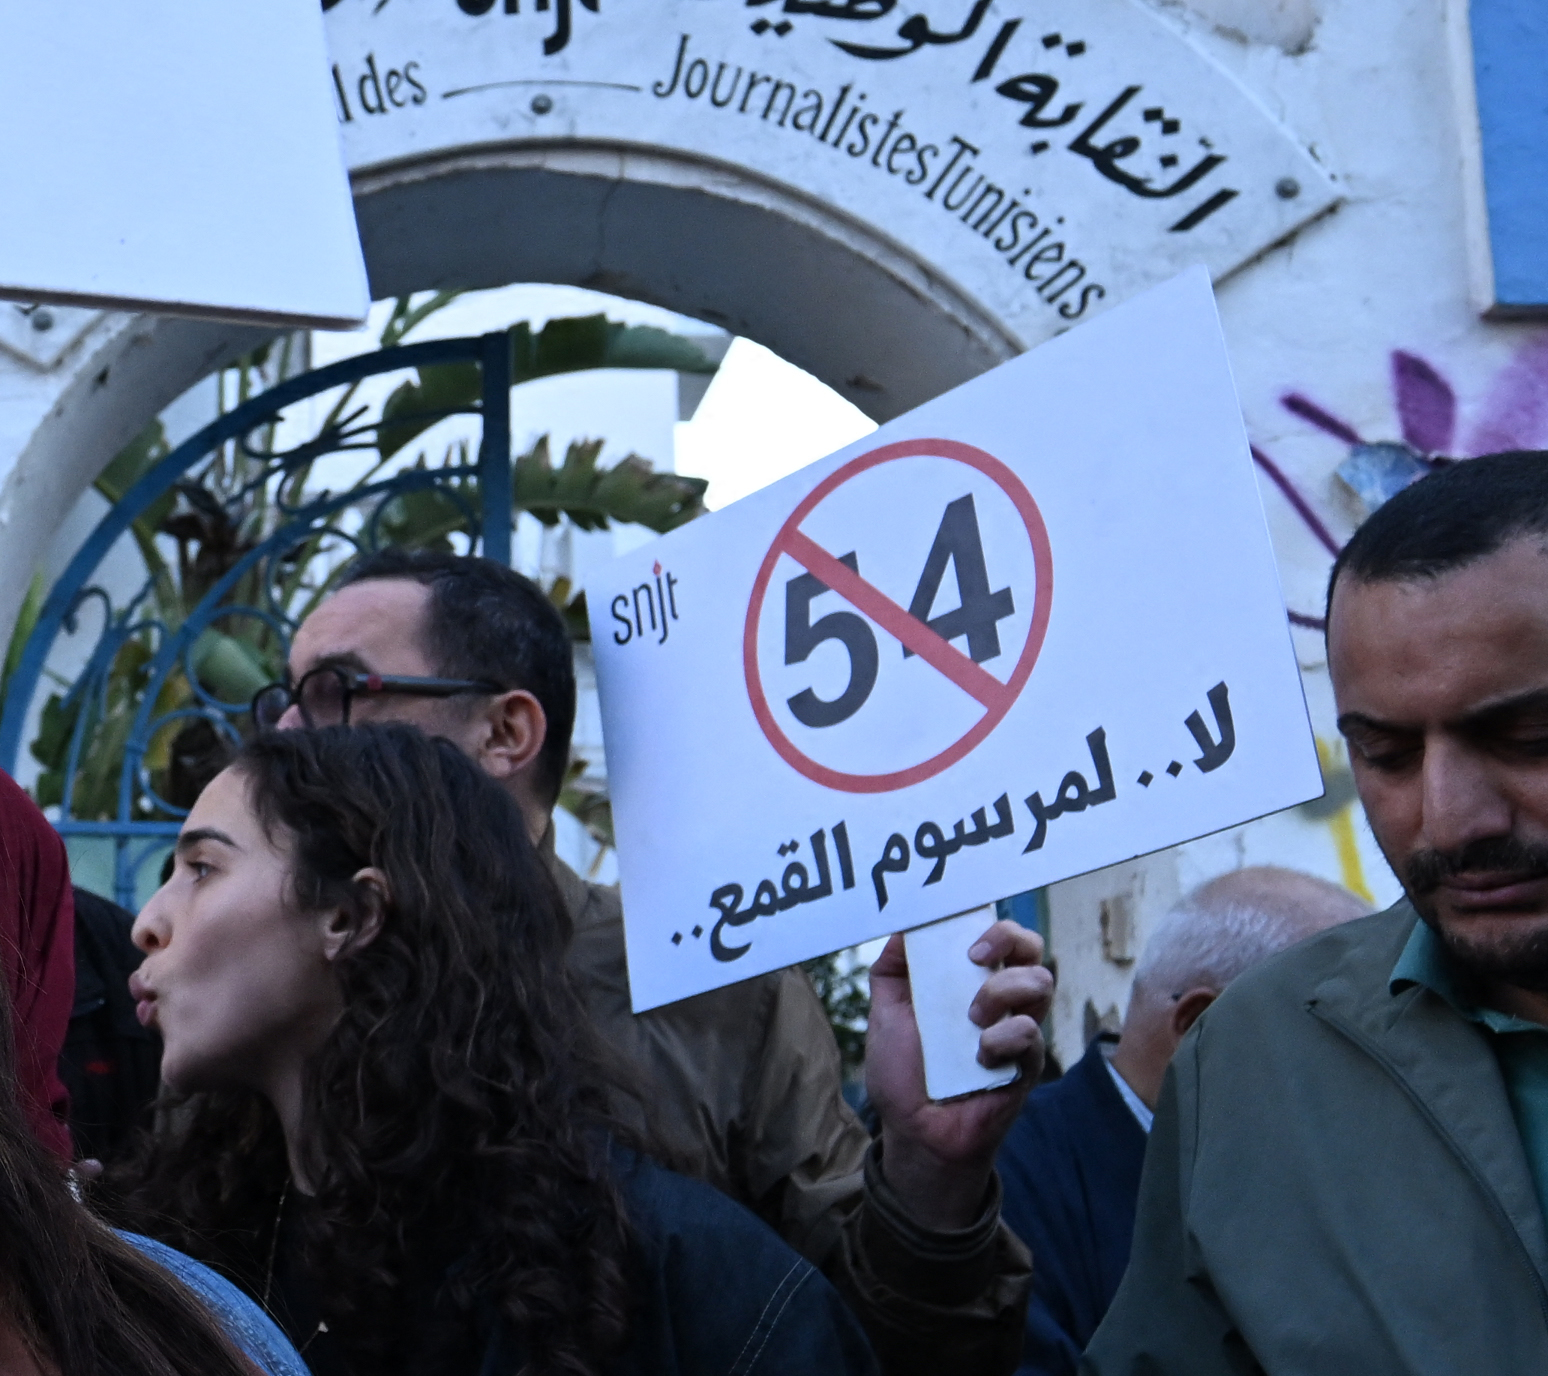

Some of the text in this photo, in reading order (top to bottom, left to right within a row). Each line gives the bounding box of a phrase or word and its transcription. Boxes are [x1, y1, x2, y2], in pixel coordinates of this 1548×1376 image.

[358, 33, 1106, 321] des Journalistes Tunisiens
[610, 561, 680, 646] snjt
[783, 492, 1016, 729] 54
[870, 726, 1117, 912] لمرسوم
